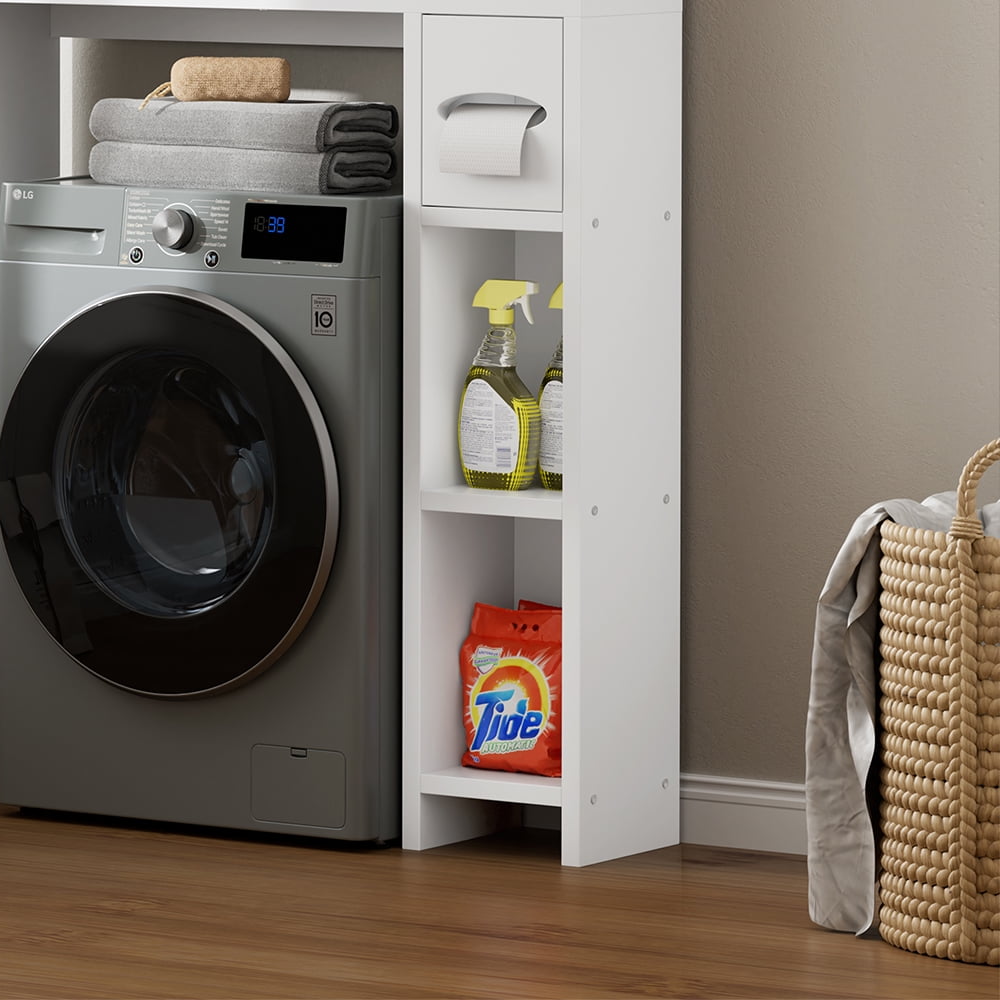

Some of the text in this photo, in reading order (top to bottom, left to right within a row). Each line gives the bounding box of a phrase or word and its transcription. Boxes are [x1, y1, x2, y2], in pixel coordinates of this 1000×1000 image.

[22, 190, 34, 200] LG
[314, 311, 333, 328] 10
[471, 689, 543, 751] Tide
[482, 740, 535, 754] AUTOMATIC
